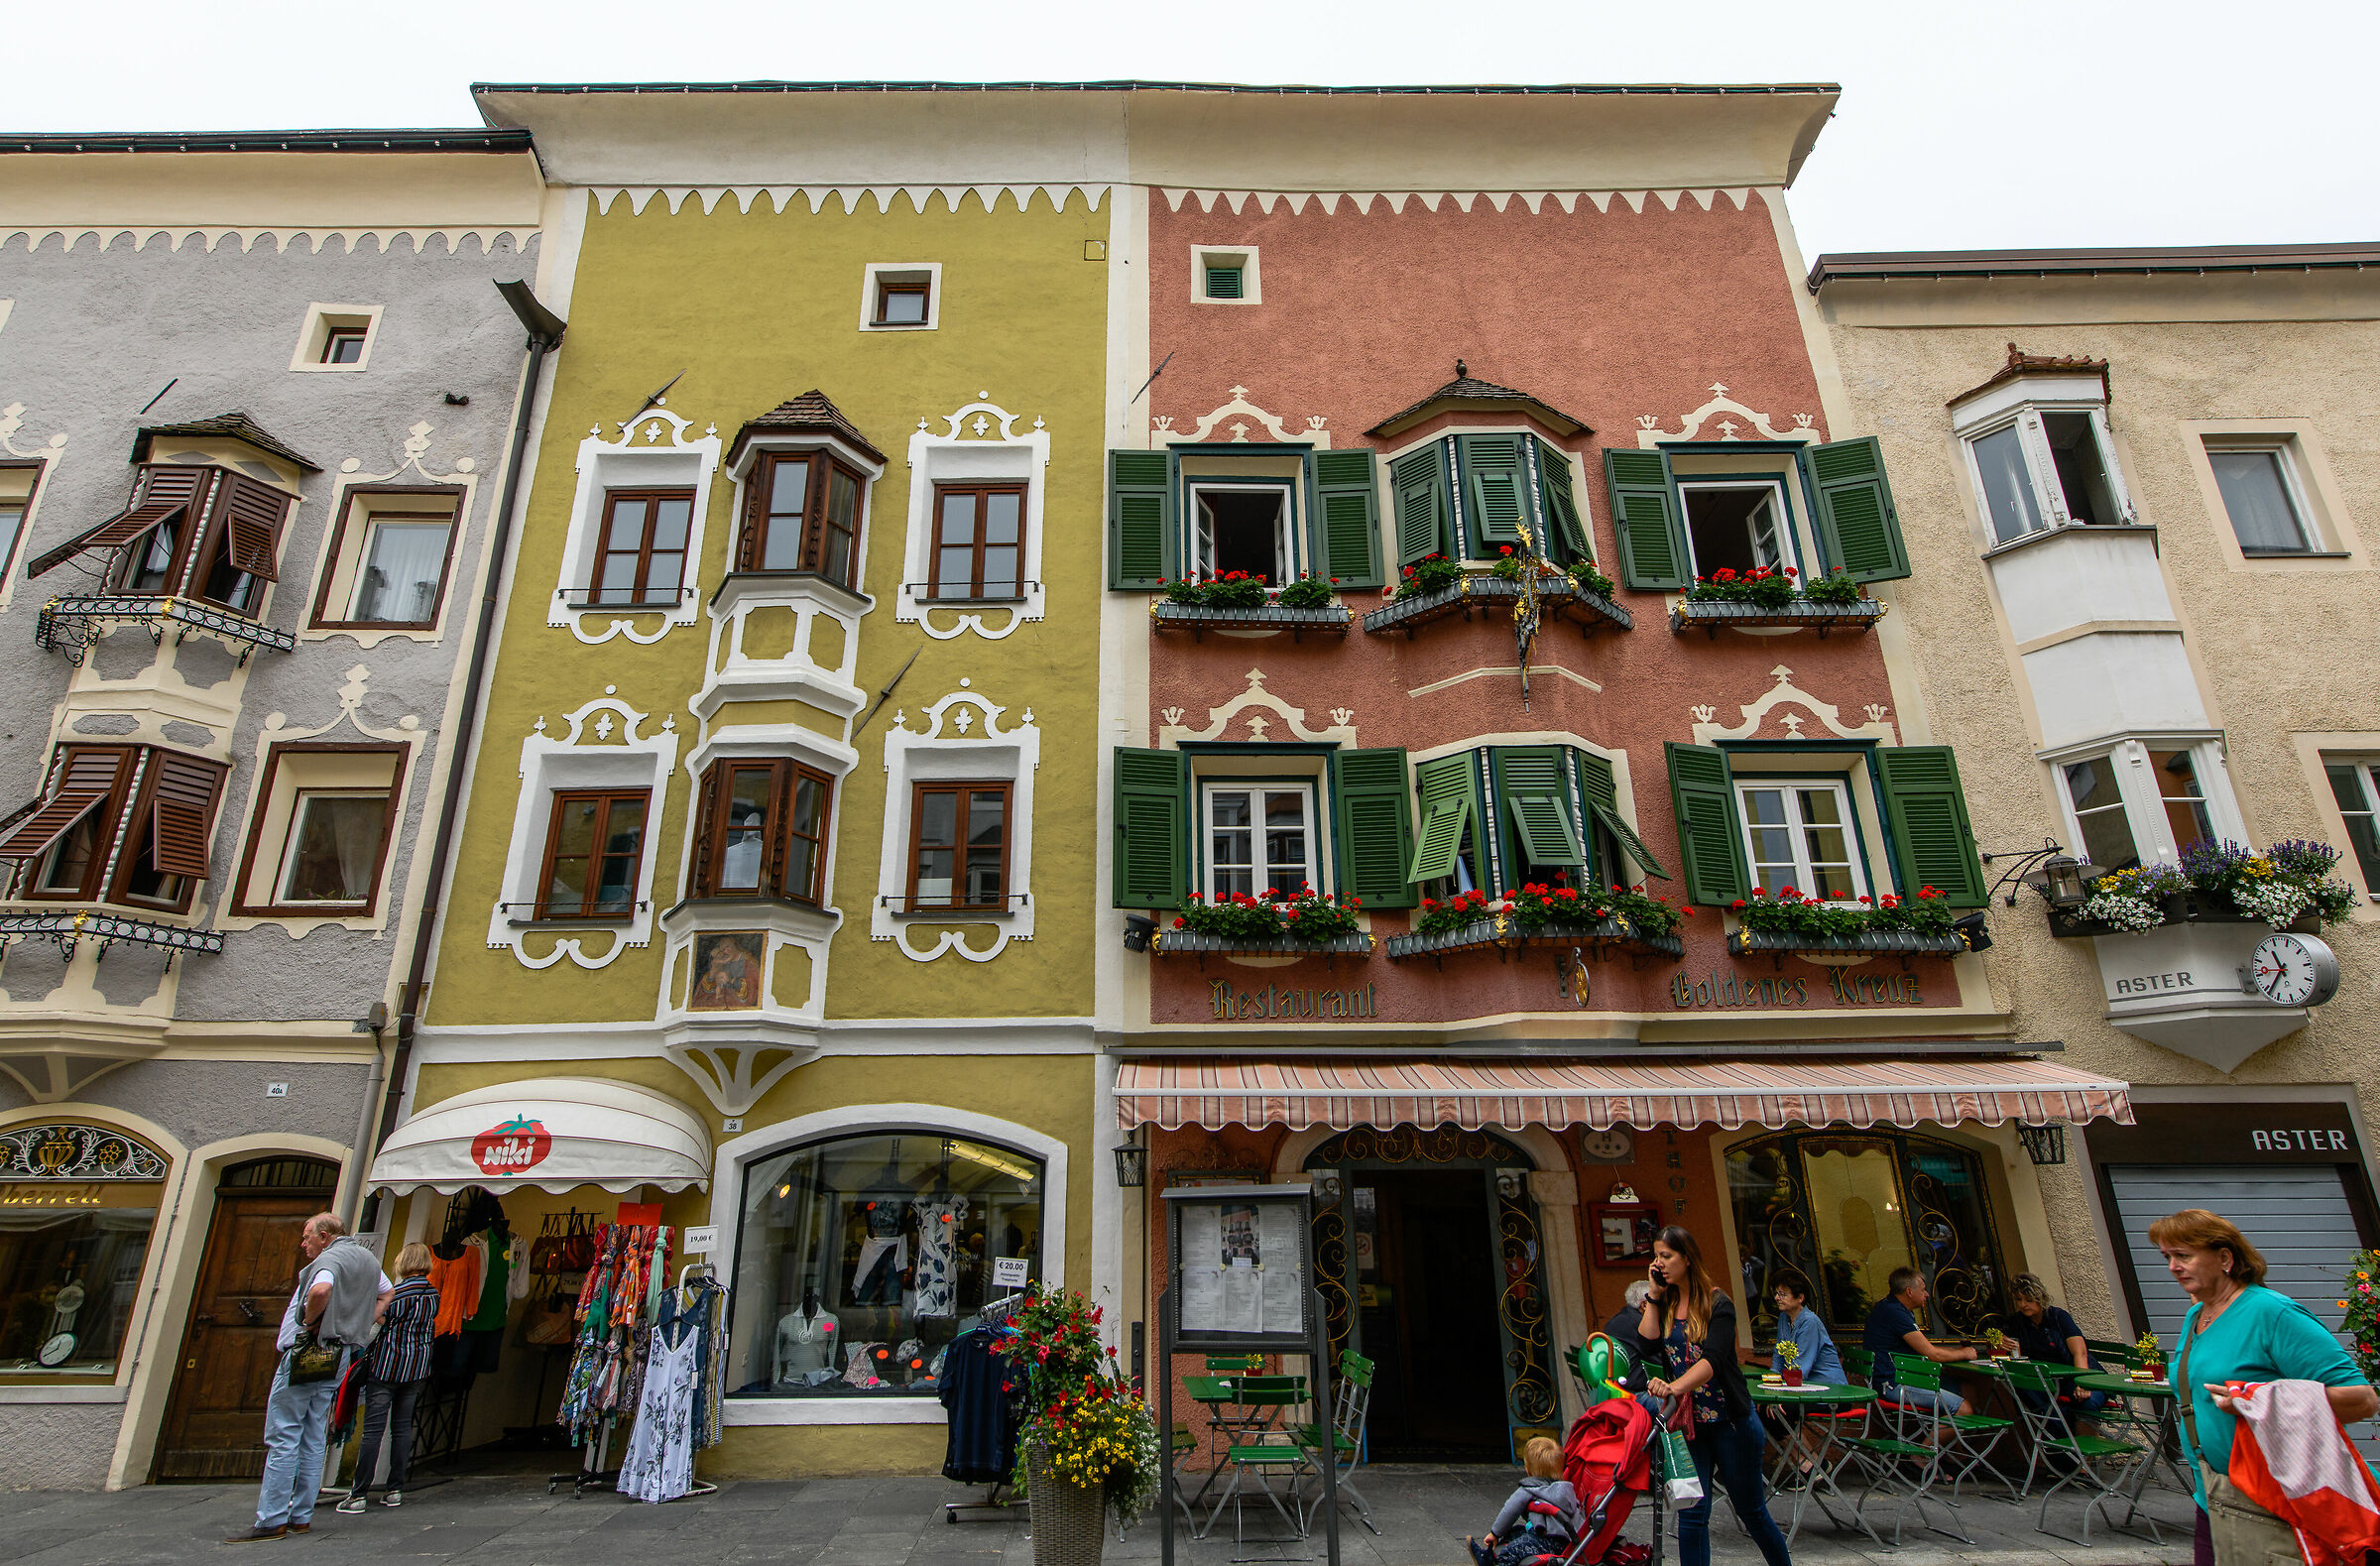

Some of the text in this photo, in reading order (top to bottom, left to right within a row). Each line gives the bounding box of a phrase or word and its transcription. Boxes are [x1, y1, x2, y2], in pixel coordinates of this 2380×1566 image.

[1672, 965, 1923, 1007] Goldenes Kreuz
[2115, 971, 2195, 994] ASTER
[1209, 980, 1379, 1019] Restaurant
[1602, 1133, 1611, 1142] H
[2252, 1130, 2348, 1150] ASTER
[483, 1137, 536, 1165] Niki
